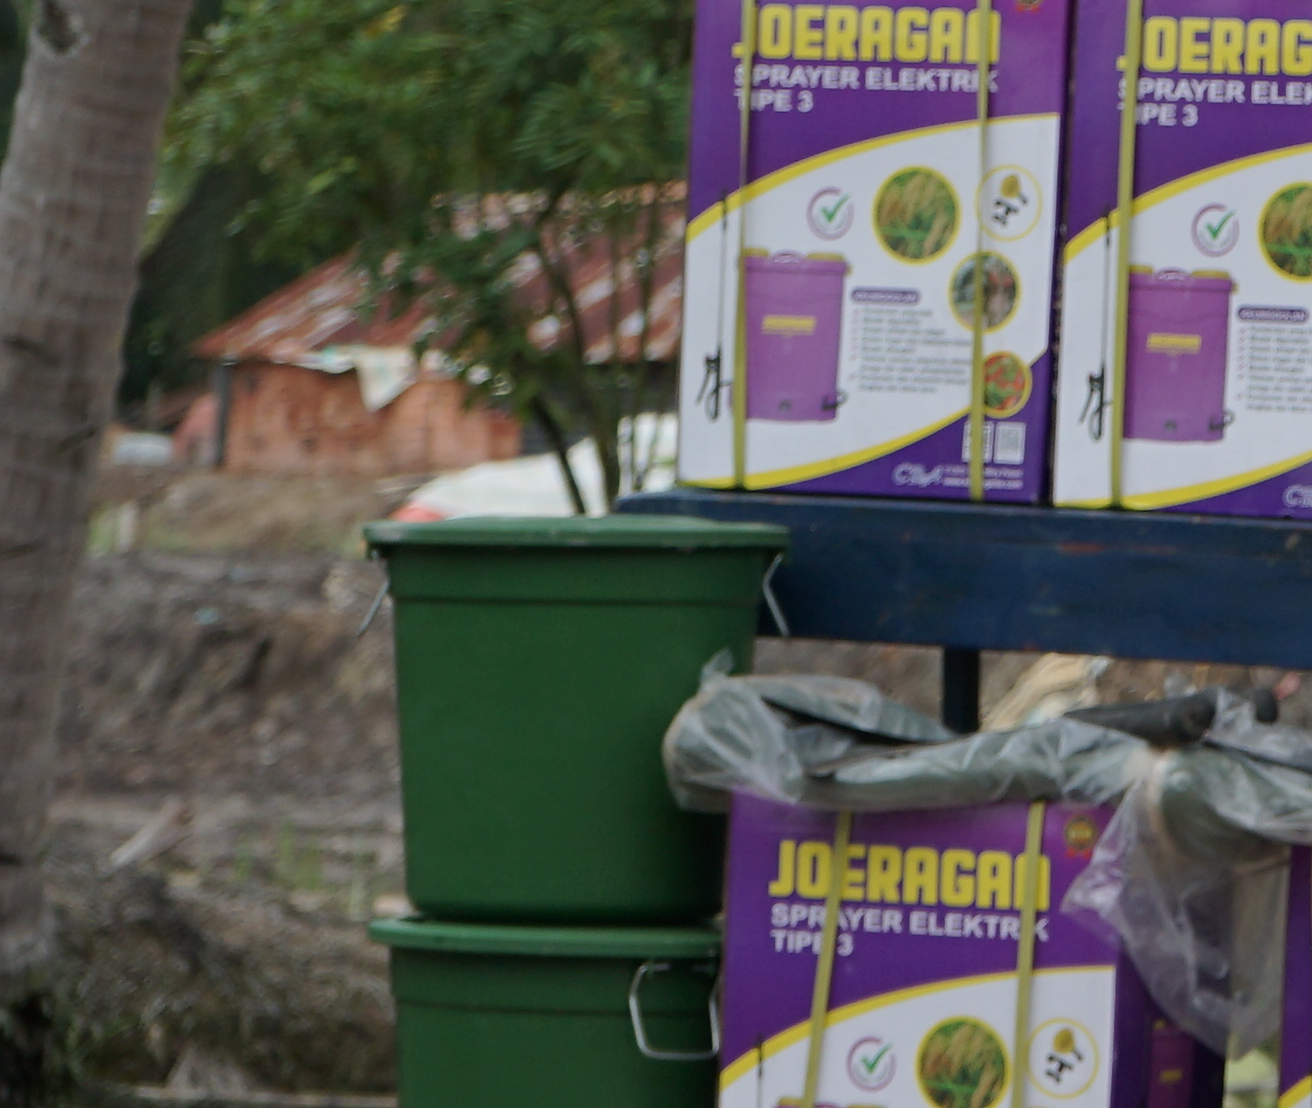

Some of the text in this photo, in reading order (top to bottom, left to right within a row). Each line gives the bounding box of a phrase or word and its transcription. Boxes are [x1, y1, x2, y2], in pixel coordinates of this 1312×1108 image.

[797, 90, 814, 113] 3
[1182, 103, 1199, 127] 3
[909, 910, 1050, 942] ELEKTRK
[836, 933, 853, 957] 3
